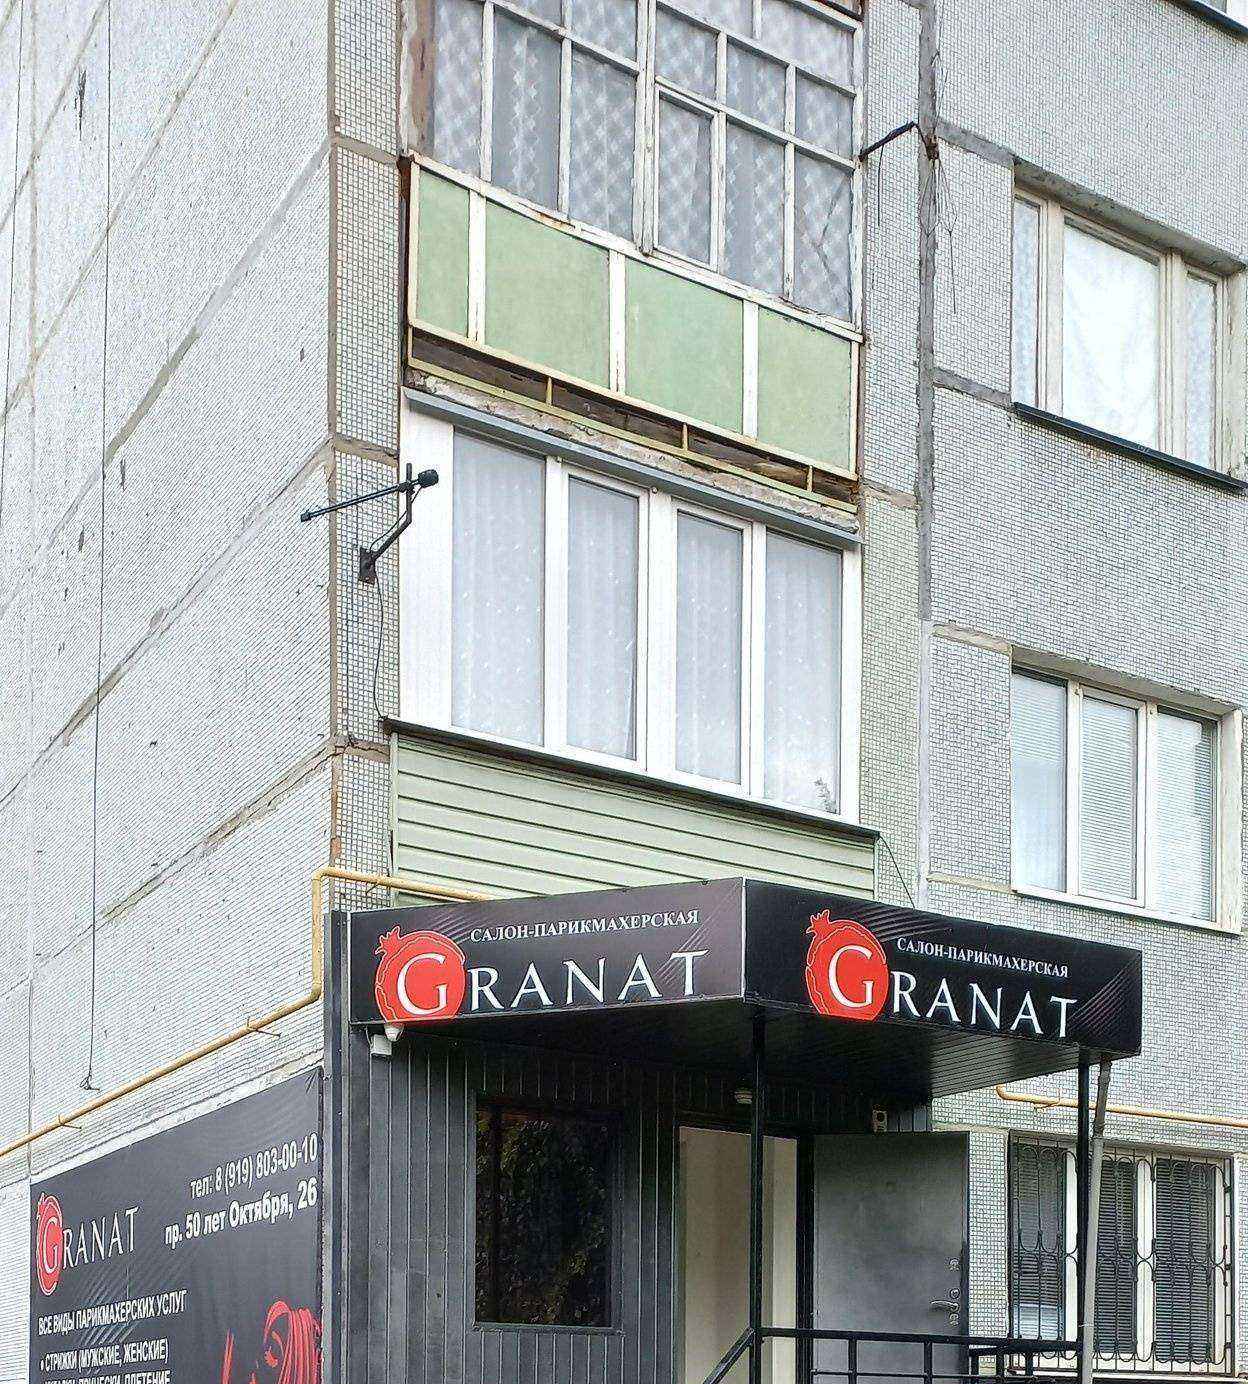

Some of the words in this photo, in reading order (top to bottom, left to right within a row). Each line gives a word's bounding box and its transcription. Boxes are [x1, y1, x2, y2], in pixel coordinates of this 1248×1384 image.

[470, 910, 699, 943] САЛОН-ПАРИКМАХЕРСКАЯ
[897, 937, 1068, 979] САЛОН-ПАРИКМАХЕРСКАЯ
[397, 949, 709, 1016] GRANAT
[828, 945, 1078, 1038] GRANAT
[190, 1176, 213, 1199] тел:
[215, 1166, 222, 1192] 8
[224, 1158, 253, 1195] (919)
[256, 1132, 318, 1179] 803-00-10
[42, 1206, 139, 1273] GRANAT
[165, 1222, 183, 1250] пр.
[186, 1211, 200, 1240] 50
[203, 1209, 227, 1235] лет
[229, 1190, 294, 1228] Октября,
[297, 1177, 318, 1209] 26
[38, 1316, 53, 1335] ВСЕ
[53, 1311, 75, 1335] ВИДЫ
[76, 1296, 155, 1330] ПАРИКМАХЕРСКИХ
[156, 1289, 187, 1318] УСЛУГ
[45, 1353, 77, 1372] СТРИЖКИ
[79, 1345, 122, 1374] (МУЖСКИЕ,
[123, 1337, 168, 1365] ЖЕНСКИЕ)
